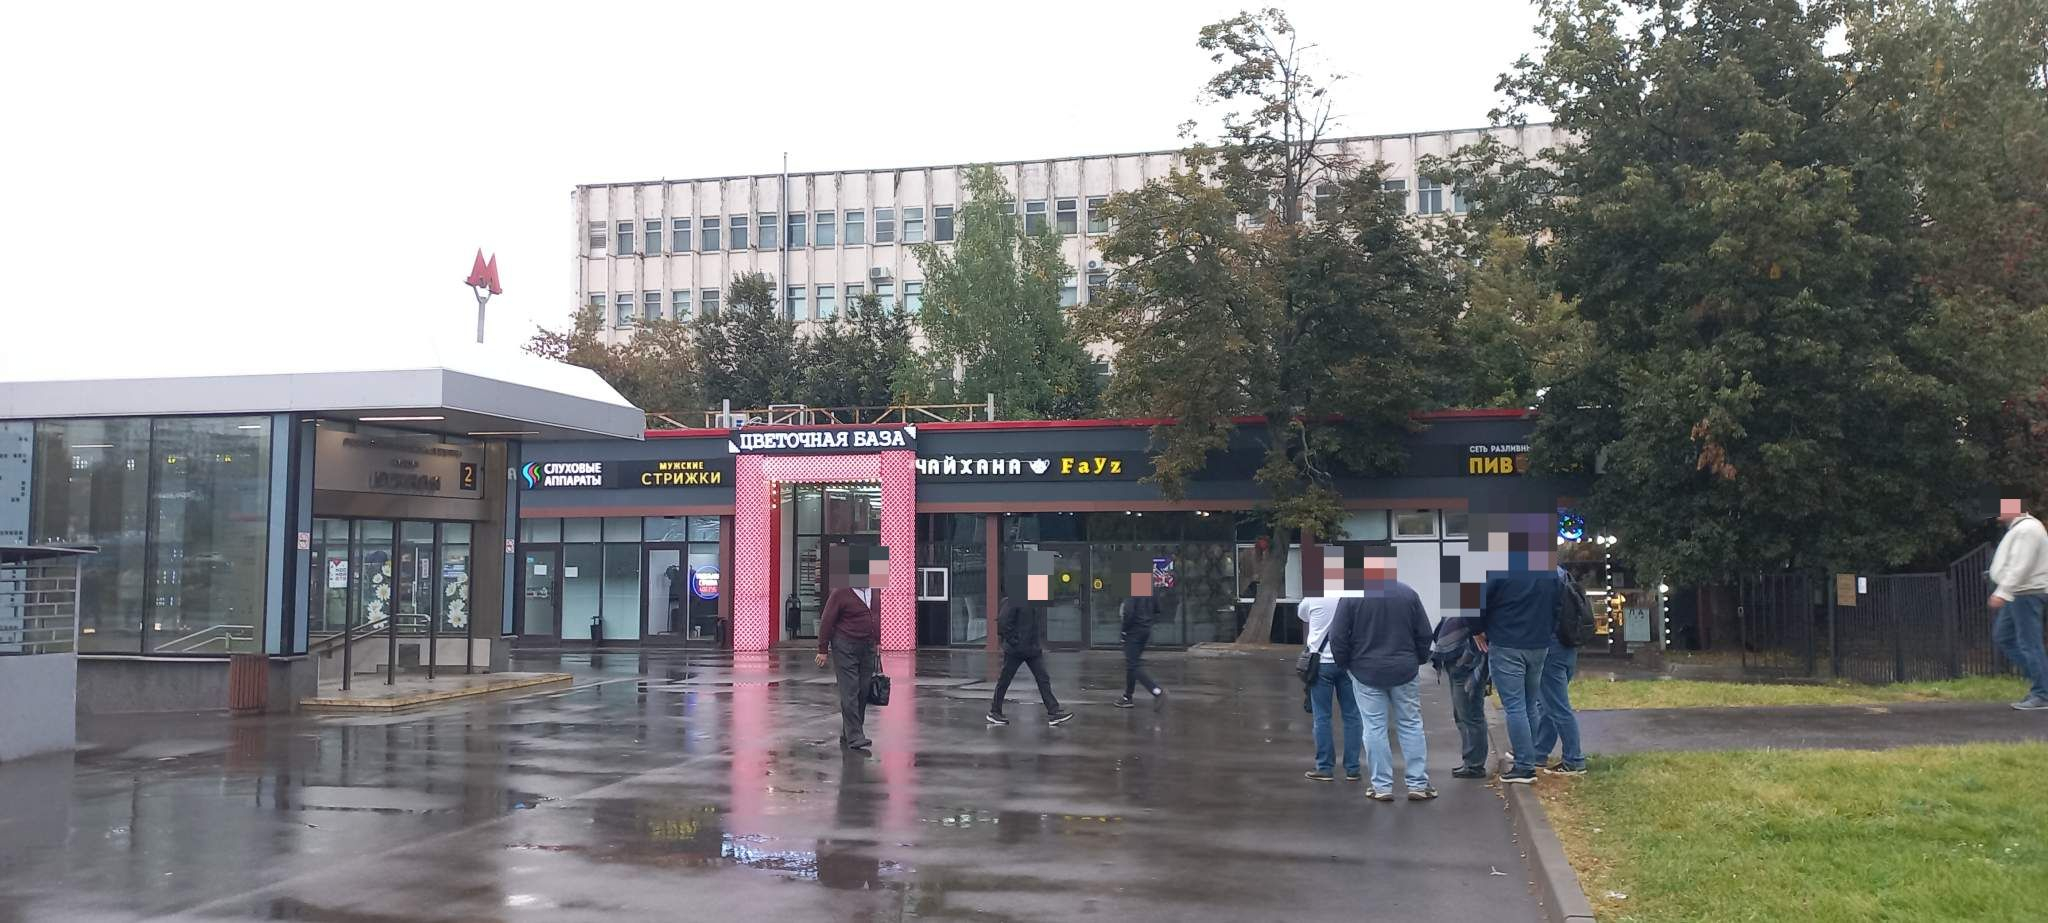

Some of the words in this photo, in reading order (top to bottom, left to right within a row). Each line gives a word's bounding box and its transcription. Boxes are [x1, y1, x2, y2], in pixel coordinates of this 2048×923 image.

[739, 431, 849, 450] ЦВЕТОЧНАЯ
[853, 430, 906, 448] БАЗА
[1469, 445, 1489, 453] СЕТЬ
[544, 462, 602, 474] СЛУХОВЫЕ
[659, 461, 704, 471] МУЖСКИЕ
[915, 455, 1021, 475] ЧАЙХАНА
[1469, 456, 1529, 474] ПИВ
[464, 466, 474, 483] 2
[544, 474, 602, 486] АППАРАТЫ
[641, 471, 721, 486] СТРИЖКИ
